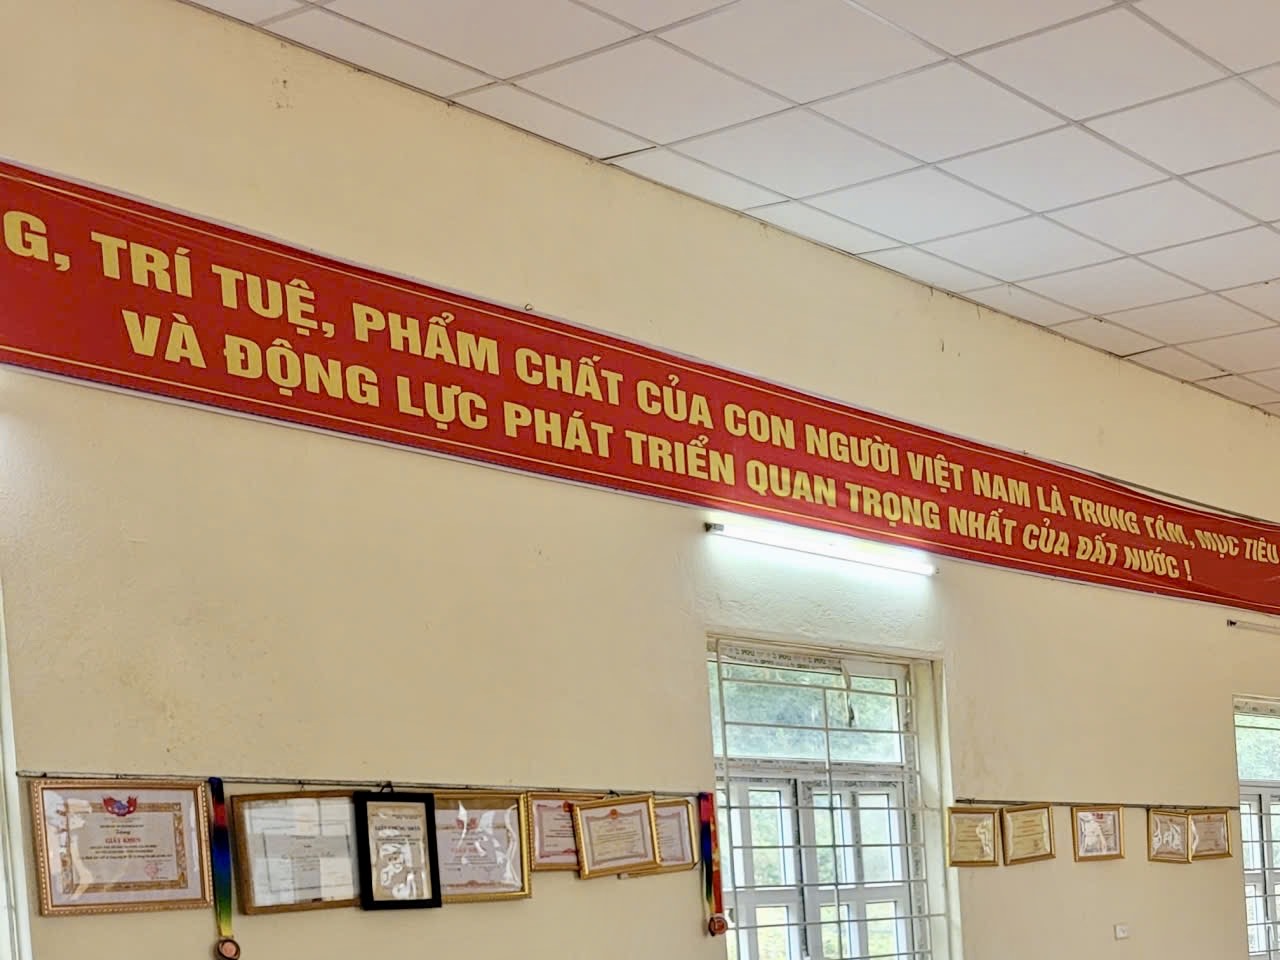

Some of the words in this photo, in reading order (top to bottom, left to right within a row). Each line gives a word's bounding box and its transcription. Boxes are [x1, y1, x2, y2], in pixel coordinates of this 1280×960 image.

[91, 231, 193, 298] TRÍ
[211, 264, 335, 338] TUỆ,
[352, 302, 500, 375] PHẨM
[515, 355, 624, 406] CHẤT
[636, 374, 714, 430] CỦA
[724, 403, 796, 450] CON
[805, 423, 900, 476] NGƯỜI
[906, 451, 964, 494] VIỆT
[971, 468, 1031, 508] NAM
[1036, 484, 1067, 517] LÀ
[1069, 495, 1141, 535] TRUNG
[1142, 514, 1196, 549] TÂM,
[1194, 528, 1240, 559] MỤC
[1243, 537, 1280, 564] TIÊU
[122, 309, 207, 369] VÀ
[223, 334, 380, 407] ĐỘNG
[396, 375, 488, 430] LỰC
[503, 401, 614, 458] PHÁT
[624, 429, 736, 486] TRIỂN
[746, 459, 837, 508] QUAN
[844, 482, 941, 531] TRỌNG
[948, 506, 1017, 546] NHẤT
[1022, 518, 1070, 557] CỦA
[1075, 532, 1118, 566] ĐẤT
[1123, 546, 1180, 578] NƯỚC
[1183, 559, 1194, 582] !
